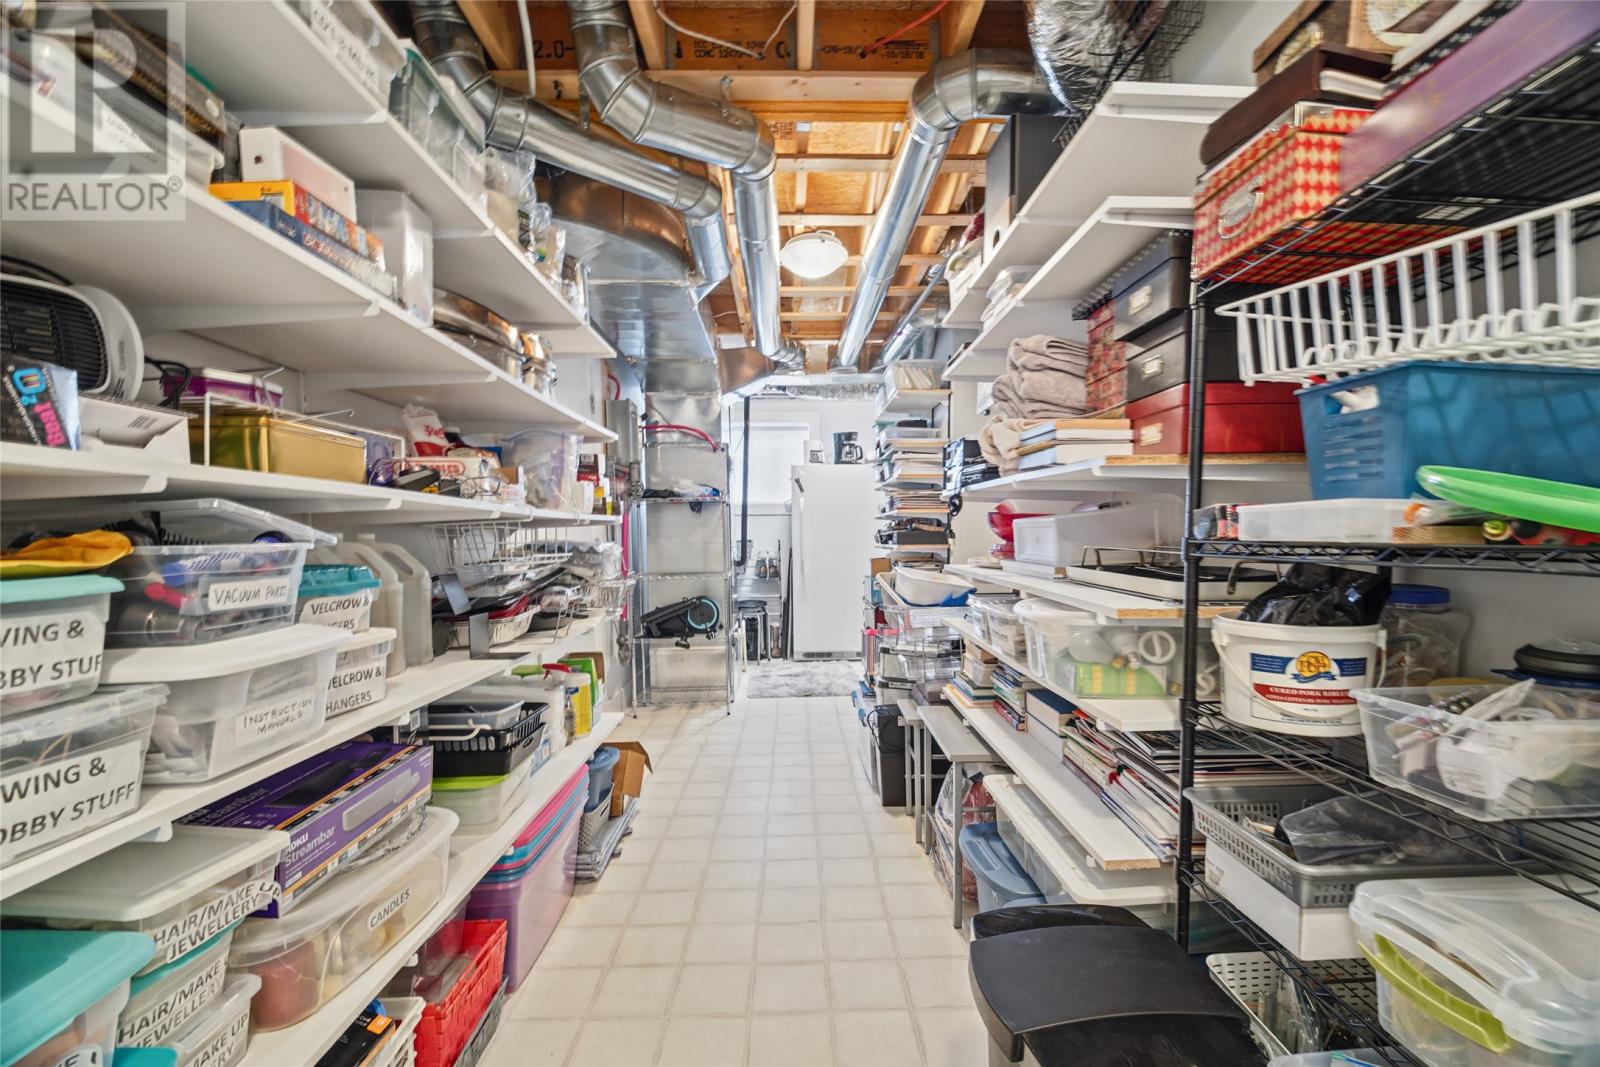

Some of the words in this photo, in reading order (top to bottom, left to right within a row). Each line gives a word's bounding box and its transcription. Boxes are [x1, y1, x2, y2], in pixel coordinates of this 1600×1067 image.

[213, 587, 262, 606] VACUUM
[310, 598, 362, 616] VELCROW
[66, 620, 84, 639] &
[375, 666, 383, 677] &
[325, 690, 372, 715] HANGERS
[88, 756, 107, 777] &
[70, 781, 136, 821] STUFF
[284, 825, 336, 867] Streambar
[154, 882, 255, 946] HAIR/MAKE
[370, 887, 410, 929] CANDLES
[169, 893, 259, 959] JEWELLERY
[117, 959, 222, 1044] HAIR/MAKE
[231, 1012, 248, 1037] UP
